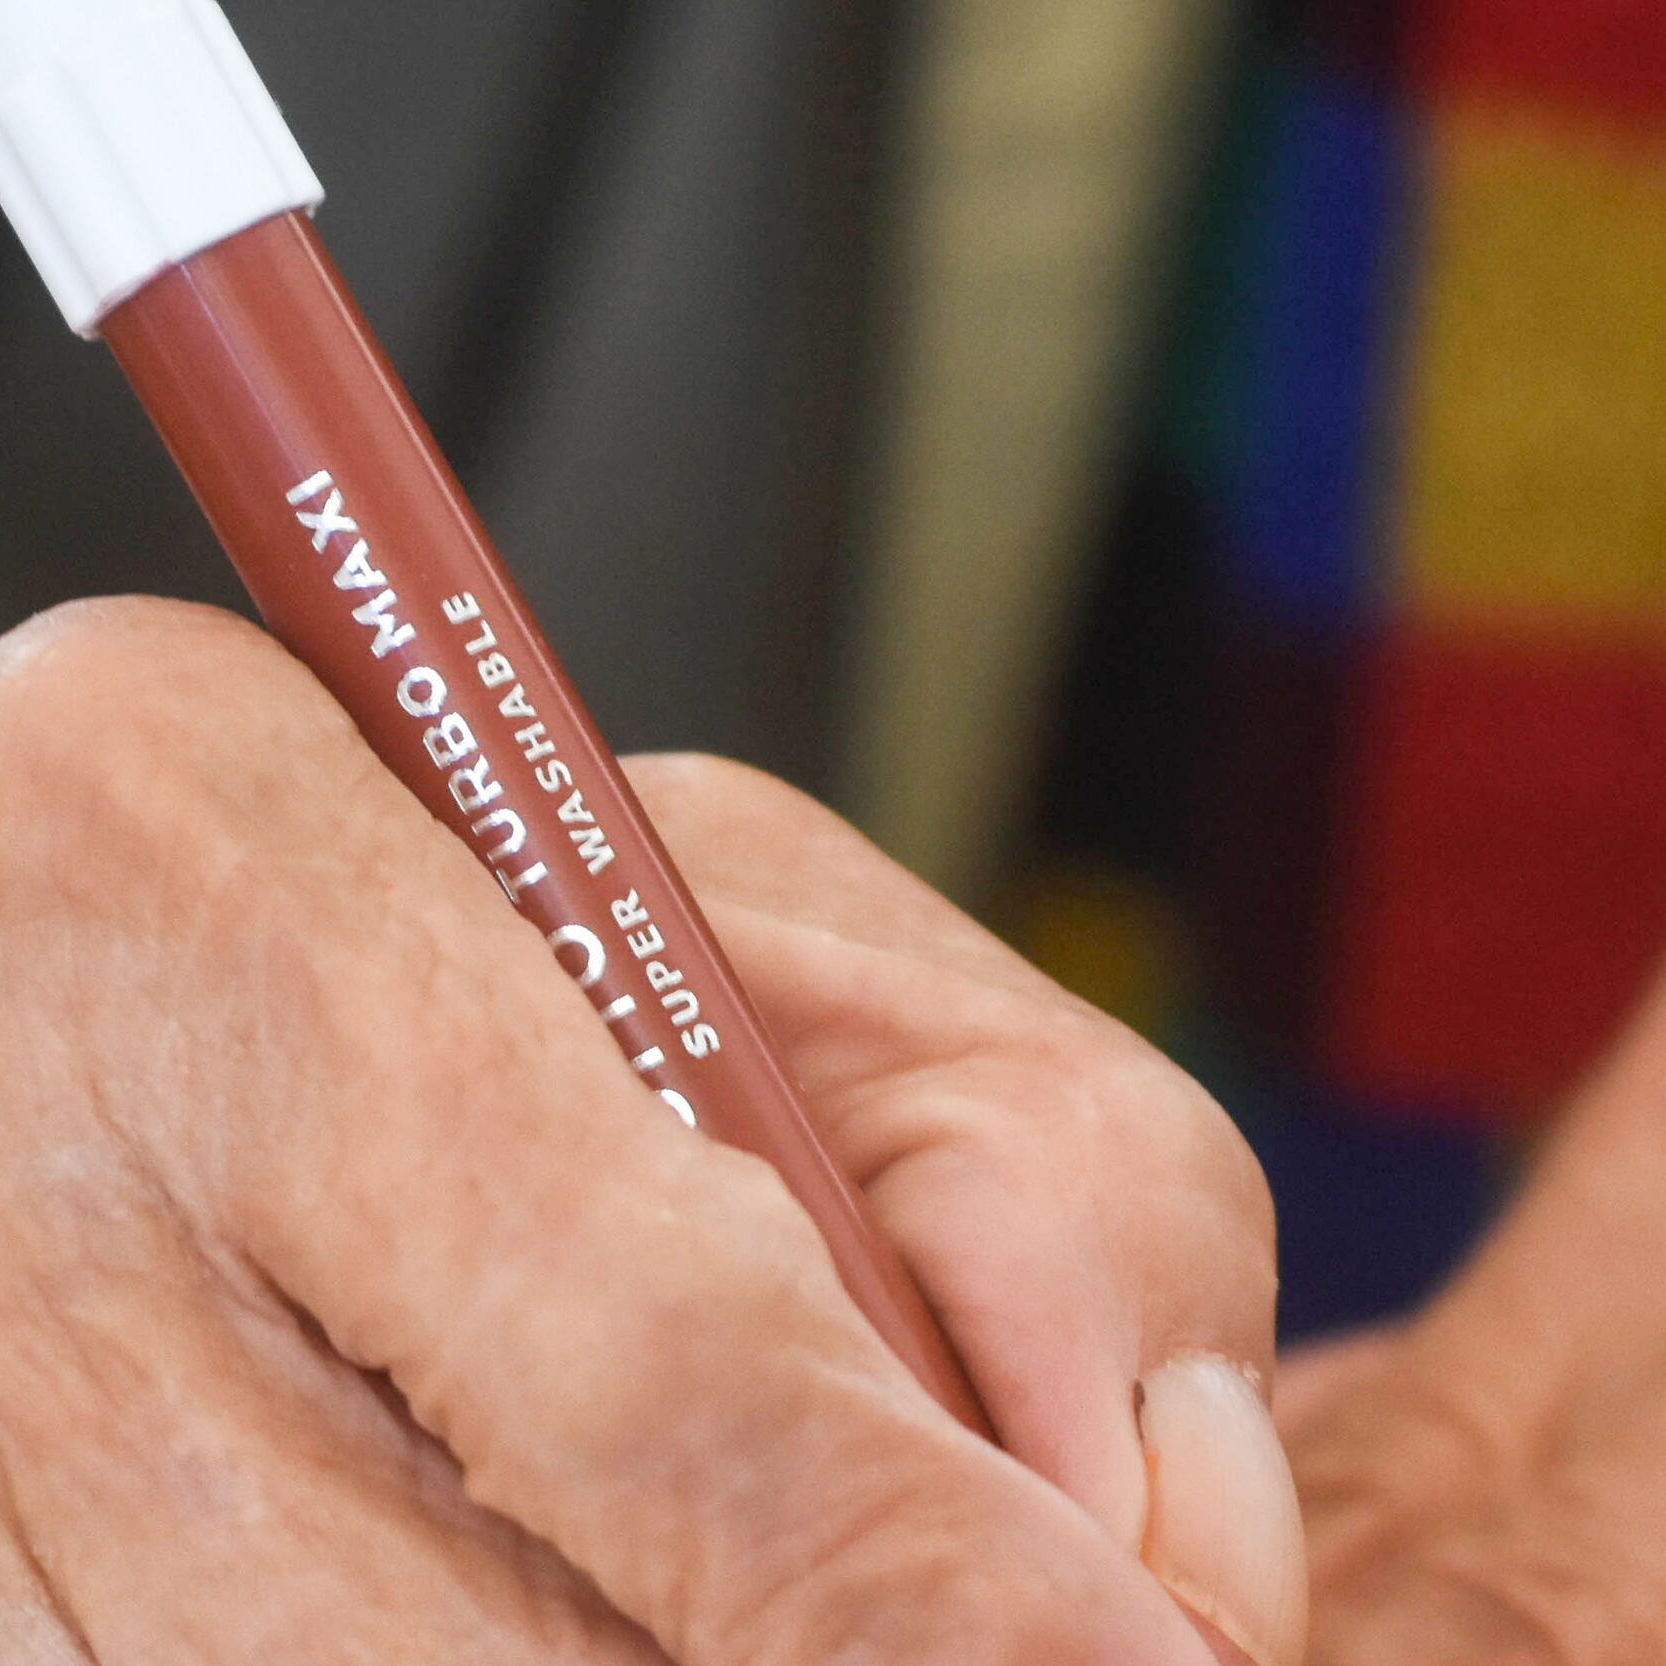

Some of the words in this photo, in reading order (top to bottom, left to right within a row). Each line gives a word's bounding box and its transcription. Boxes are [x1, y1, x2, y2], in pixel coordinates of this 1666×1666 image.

[285, 468, 416, 659] MAXI
[393, 664, 549, 902] TURBO
[440, 588, 617, 874] WASHABLE
[610, 886, 722, 1061] SUPER
